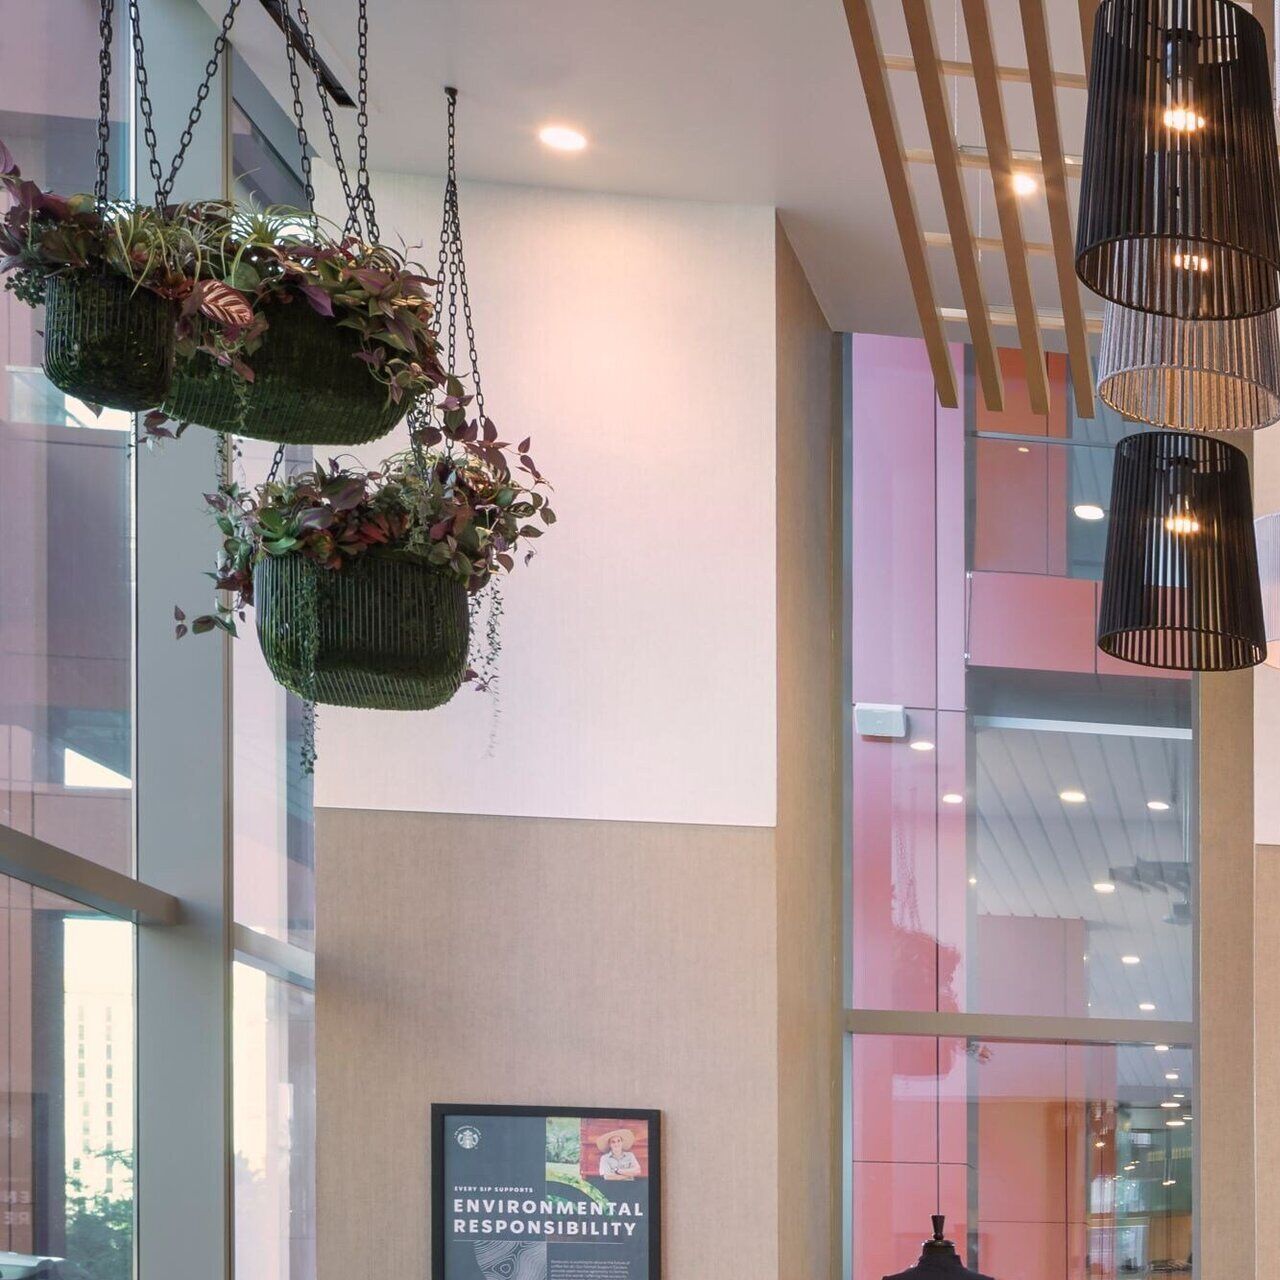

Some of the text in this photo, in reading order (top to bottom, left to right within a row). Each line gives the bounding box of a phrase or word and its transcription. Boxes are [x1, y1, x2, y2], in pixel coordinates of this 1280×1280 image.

[454, 1185, 478, 1193] EVERY
[494, 1186, 534, 1194] SUPPORTS
[453, 1198, 644, 1217] ENVIRONMENTAL
[453, 1218, 637, 1237] RESPONSIBILITY
